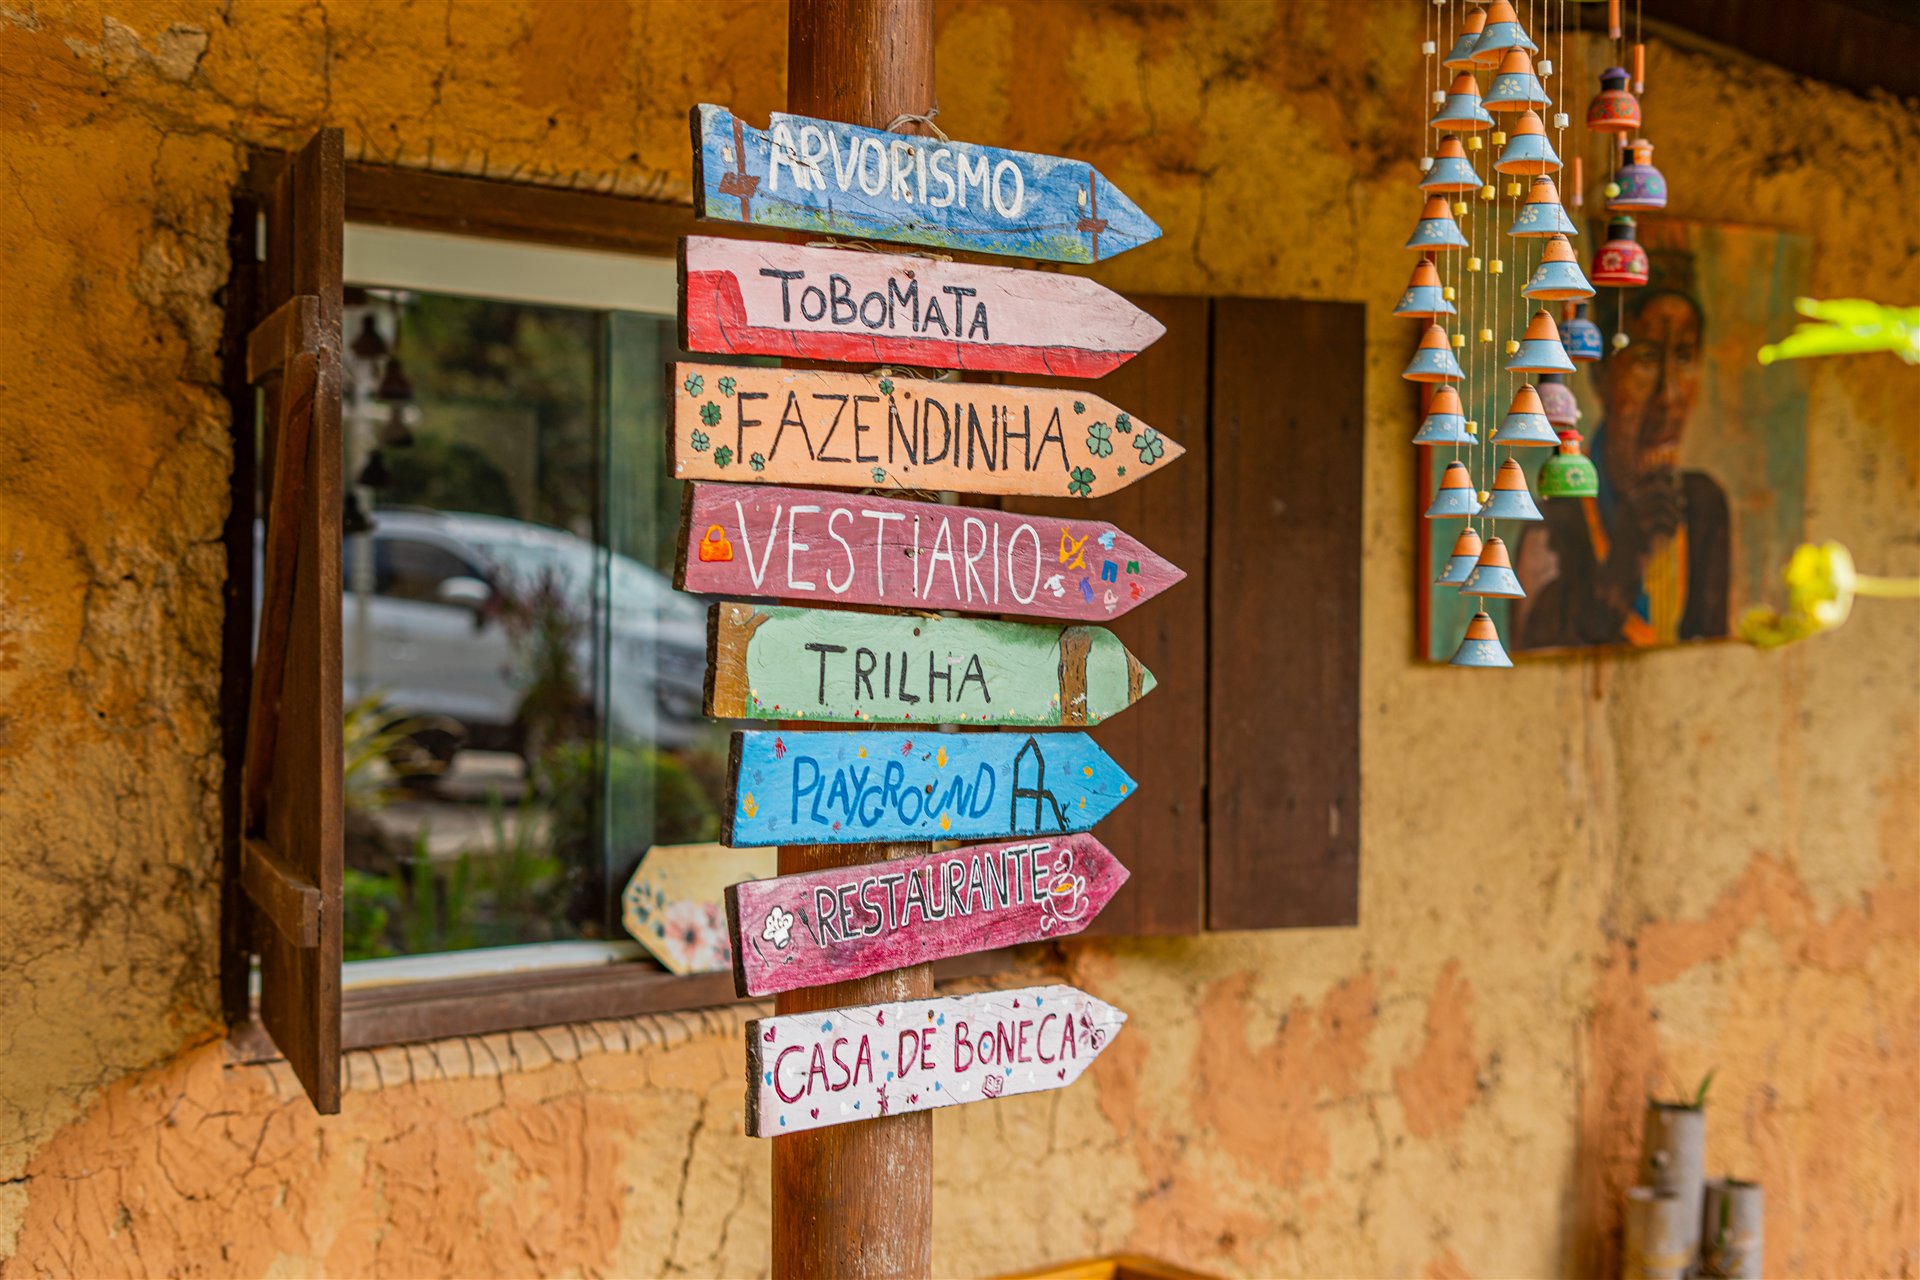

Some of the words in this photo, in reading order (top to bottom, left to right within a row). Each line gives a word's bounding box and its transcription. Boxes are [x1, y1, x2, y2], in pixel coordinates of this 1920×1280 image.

[768, 121, 1025, 219] ARVORISMO
[736, 390, 1071, 472] FAZENDINHA
[735, 500, 1042, 605] VESTIARIO
[804, 642, 992, 705] TRILHA
[791, 755, 996, 828] PLAYGROUND
[814, 842, 1050, 949] RESTAURANTE
[773, 1034, 874, 1104] CASA
[897, 1027, 937, 1079] DE
[954, 1012, 1077, 1074] BONECA
